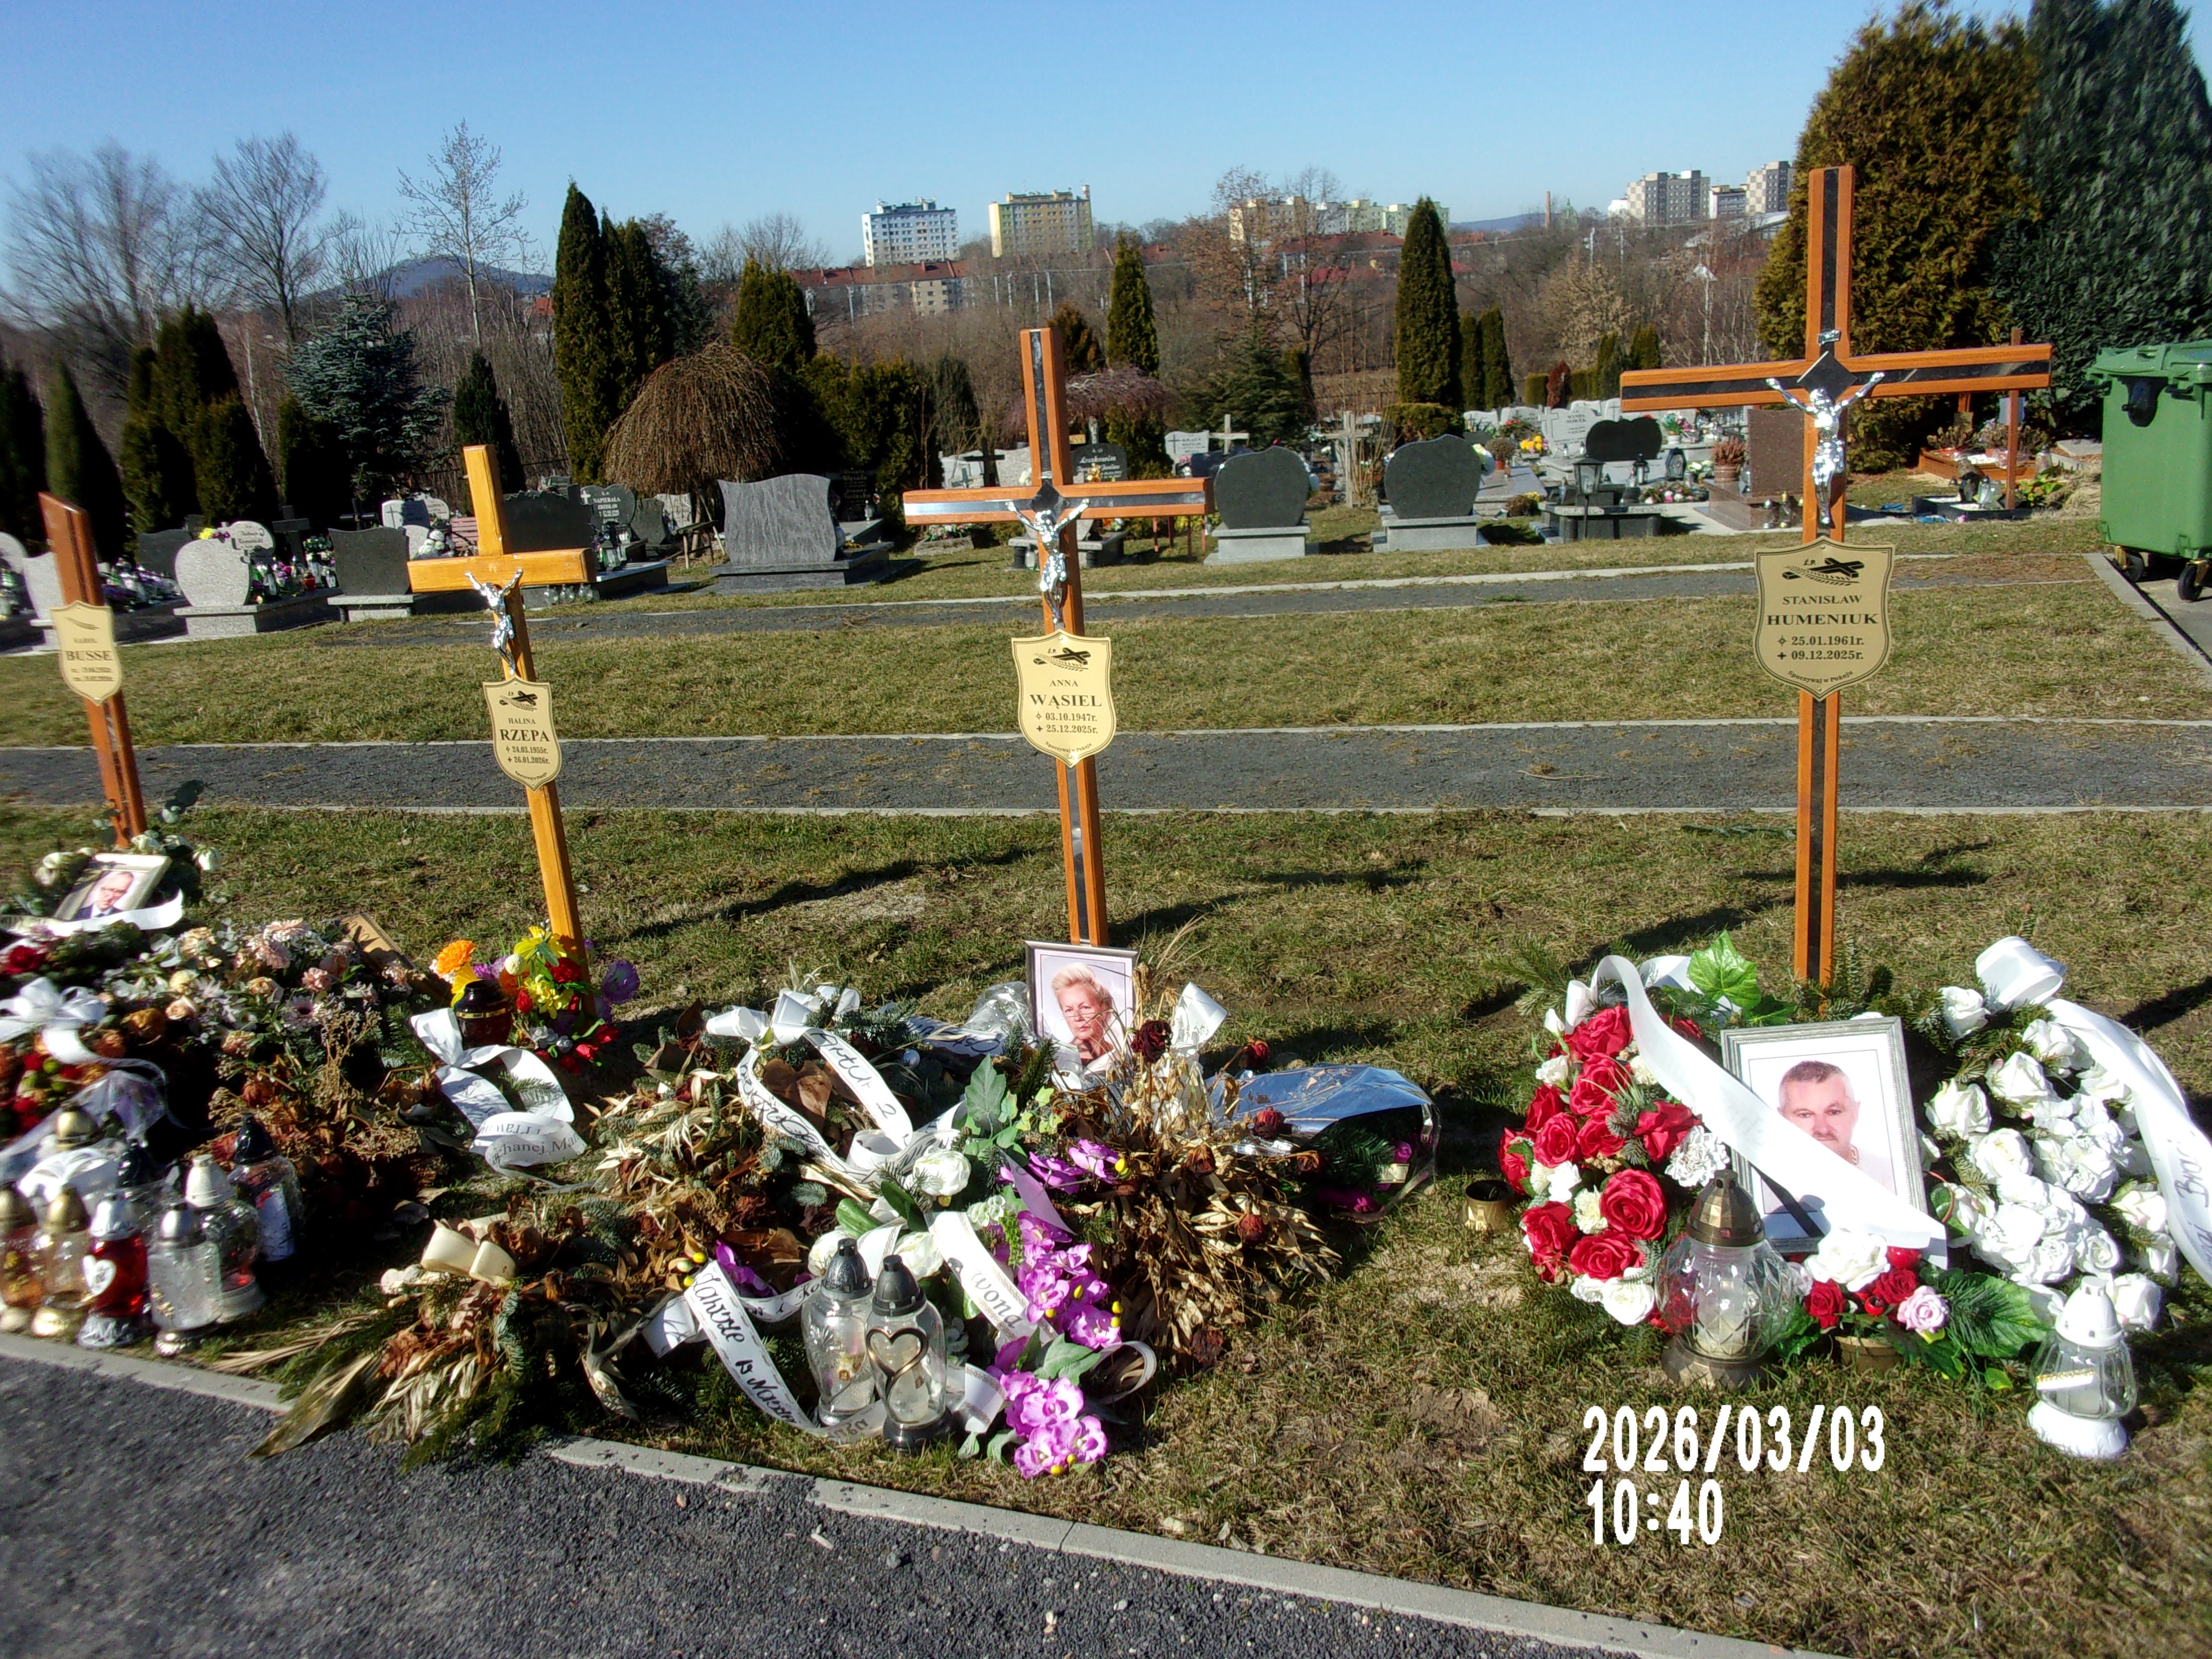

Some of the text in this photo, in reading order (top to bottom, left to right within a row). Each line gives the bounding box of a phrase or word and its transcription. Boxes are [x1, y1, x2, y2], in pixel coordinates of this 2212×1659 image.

[1782, 595, 1862, 605] STANISŁAW
[1767, 613, 1878, 625] HUMENIUK
[1791, 636, 1864, 646] 25.01.1961r.
[66, 650, 112, 661] BUSSE
[1791, 650, 1864, 660] 09.12.2025r.
[1788, 670, 1822, 684] Spoczywaj
[1830, 671, 1853, 682] Pokoju
[1029, 694, 1102, 709] WĄSIEL
[1045, 712, 1097, 721] 03.10.1947r.
[1046, 725, 1098, 733] 25.12.2025r.
[499, 729, 550, 742] RZEPA
[1045, 741, 1070, 753] Spoczywaj
[1076, 743, 1092, 752] Pokoju
[809, 1032, 872, 1088] Artur
